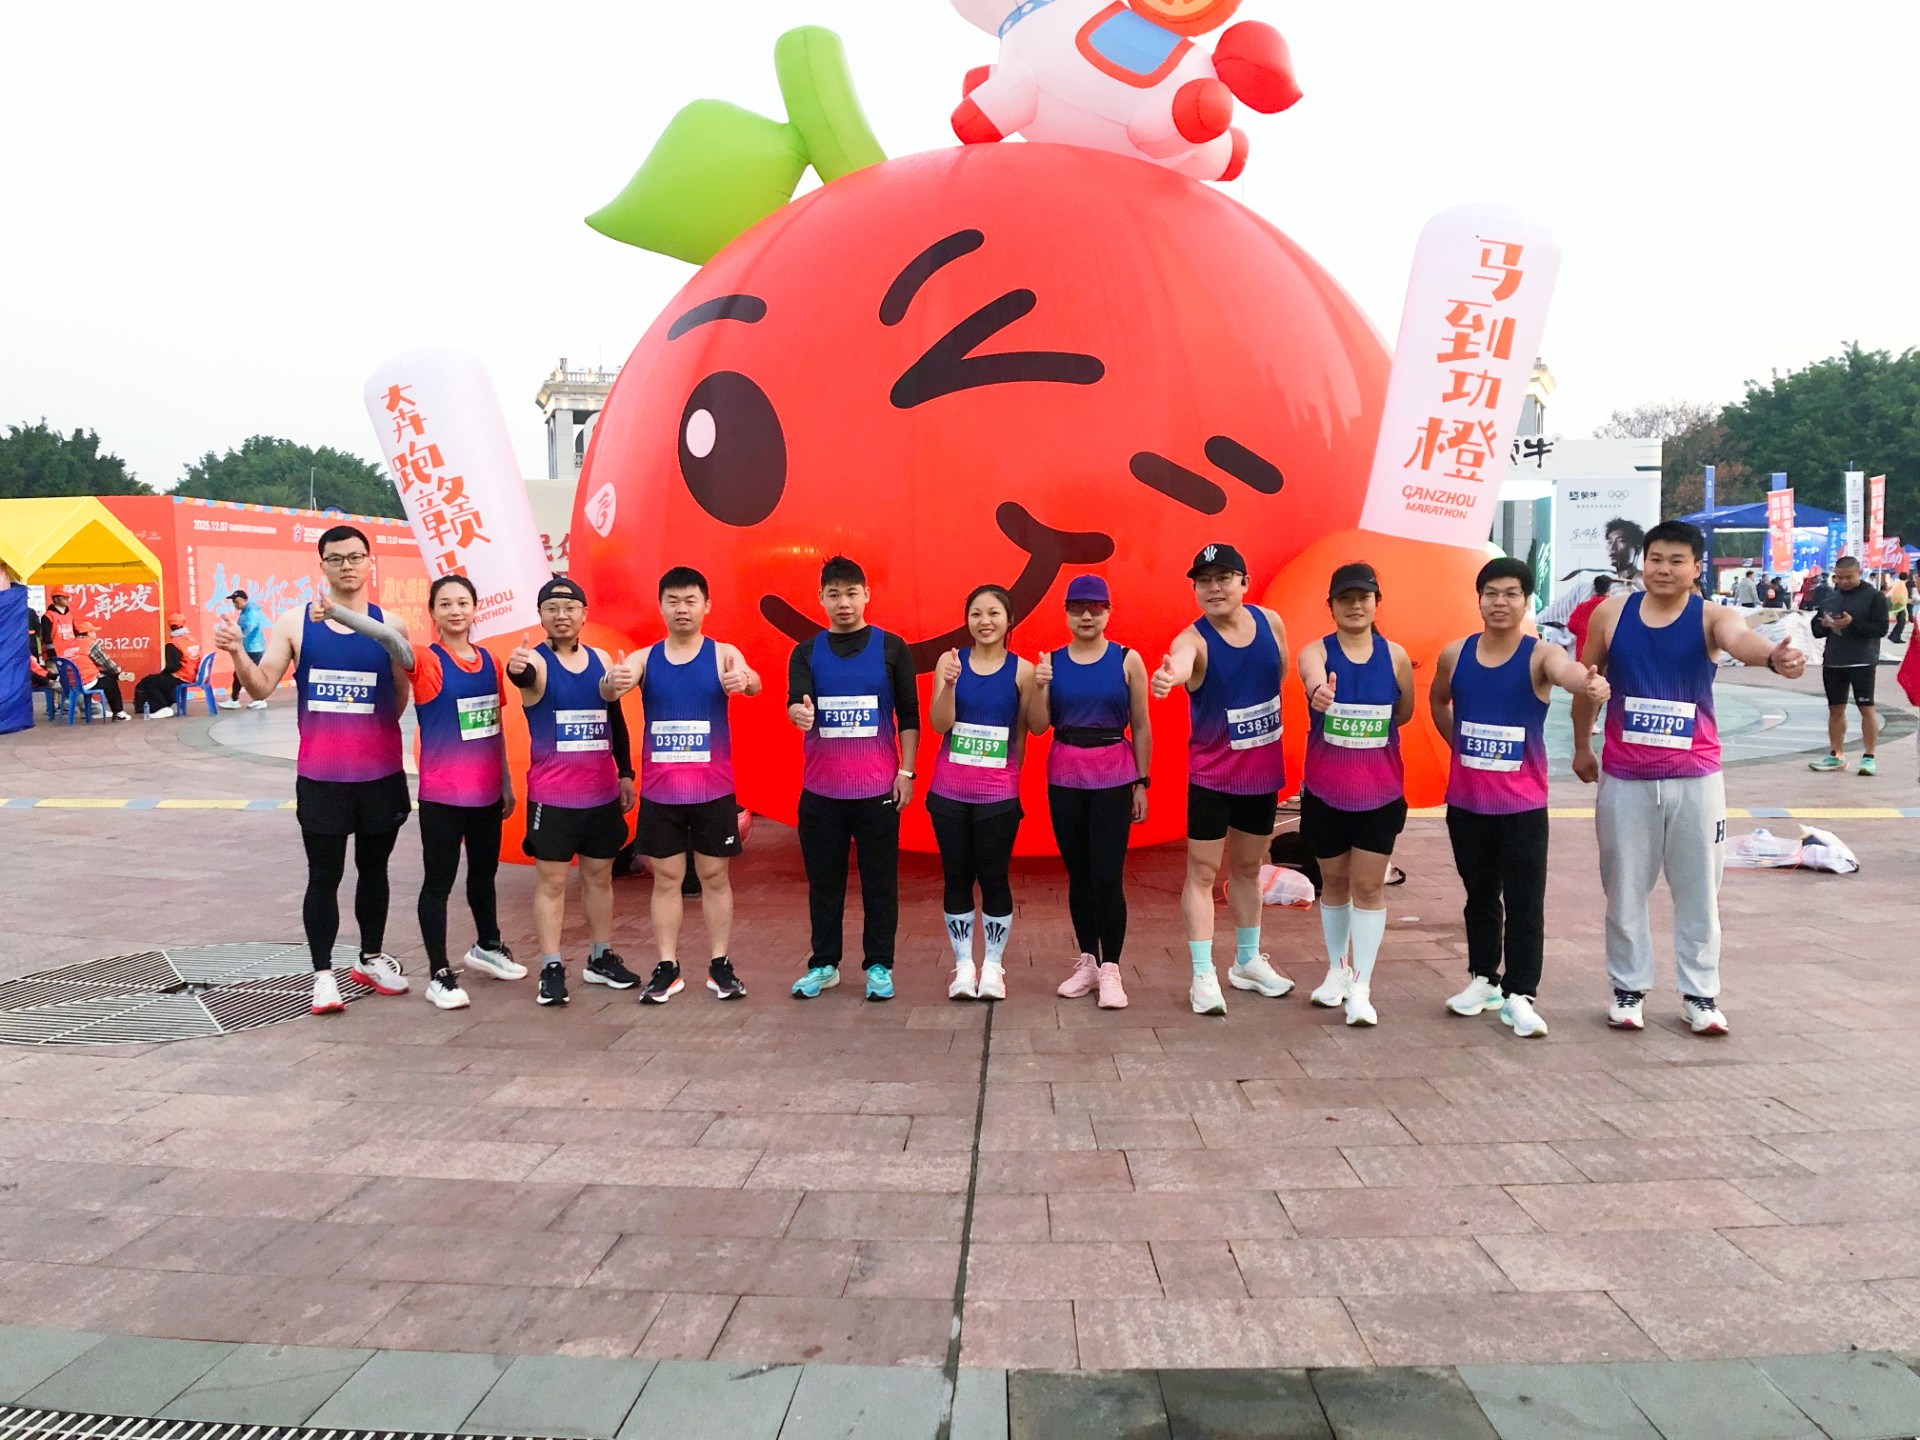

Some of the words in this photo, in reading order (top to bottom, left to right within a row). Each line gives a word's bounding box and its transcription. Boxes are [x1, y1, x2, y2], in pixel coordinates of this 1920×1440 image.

[1403, 238, 1524, 483] 马到功橙
[1402, 485, 1477, 508] GANZHOU
[1405, 502, 1468, 519] MARATHON
[85, 583, 161, 620] 再出发
[476, 589, 514, 611] ZHOU
[474, 604, 513, 625] RATHON
[96, 637, 151, 650] 25.12.07
[316, 684, 369, 698] D35293
[825, 710, 871, 722] F30765
[1237, 712, 1280, 735] C38378
[1632, 713, 1685, 731] F37190
[565, 723, 605, 736] F37569
[1332, 718, 1383, 732] E66968
[656, 734, 704, 747] D39080
[957, 737, 1000, 752] F61359
[1467, 738, 1513, 755] E31831
